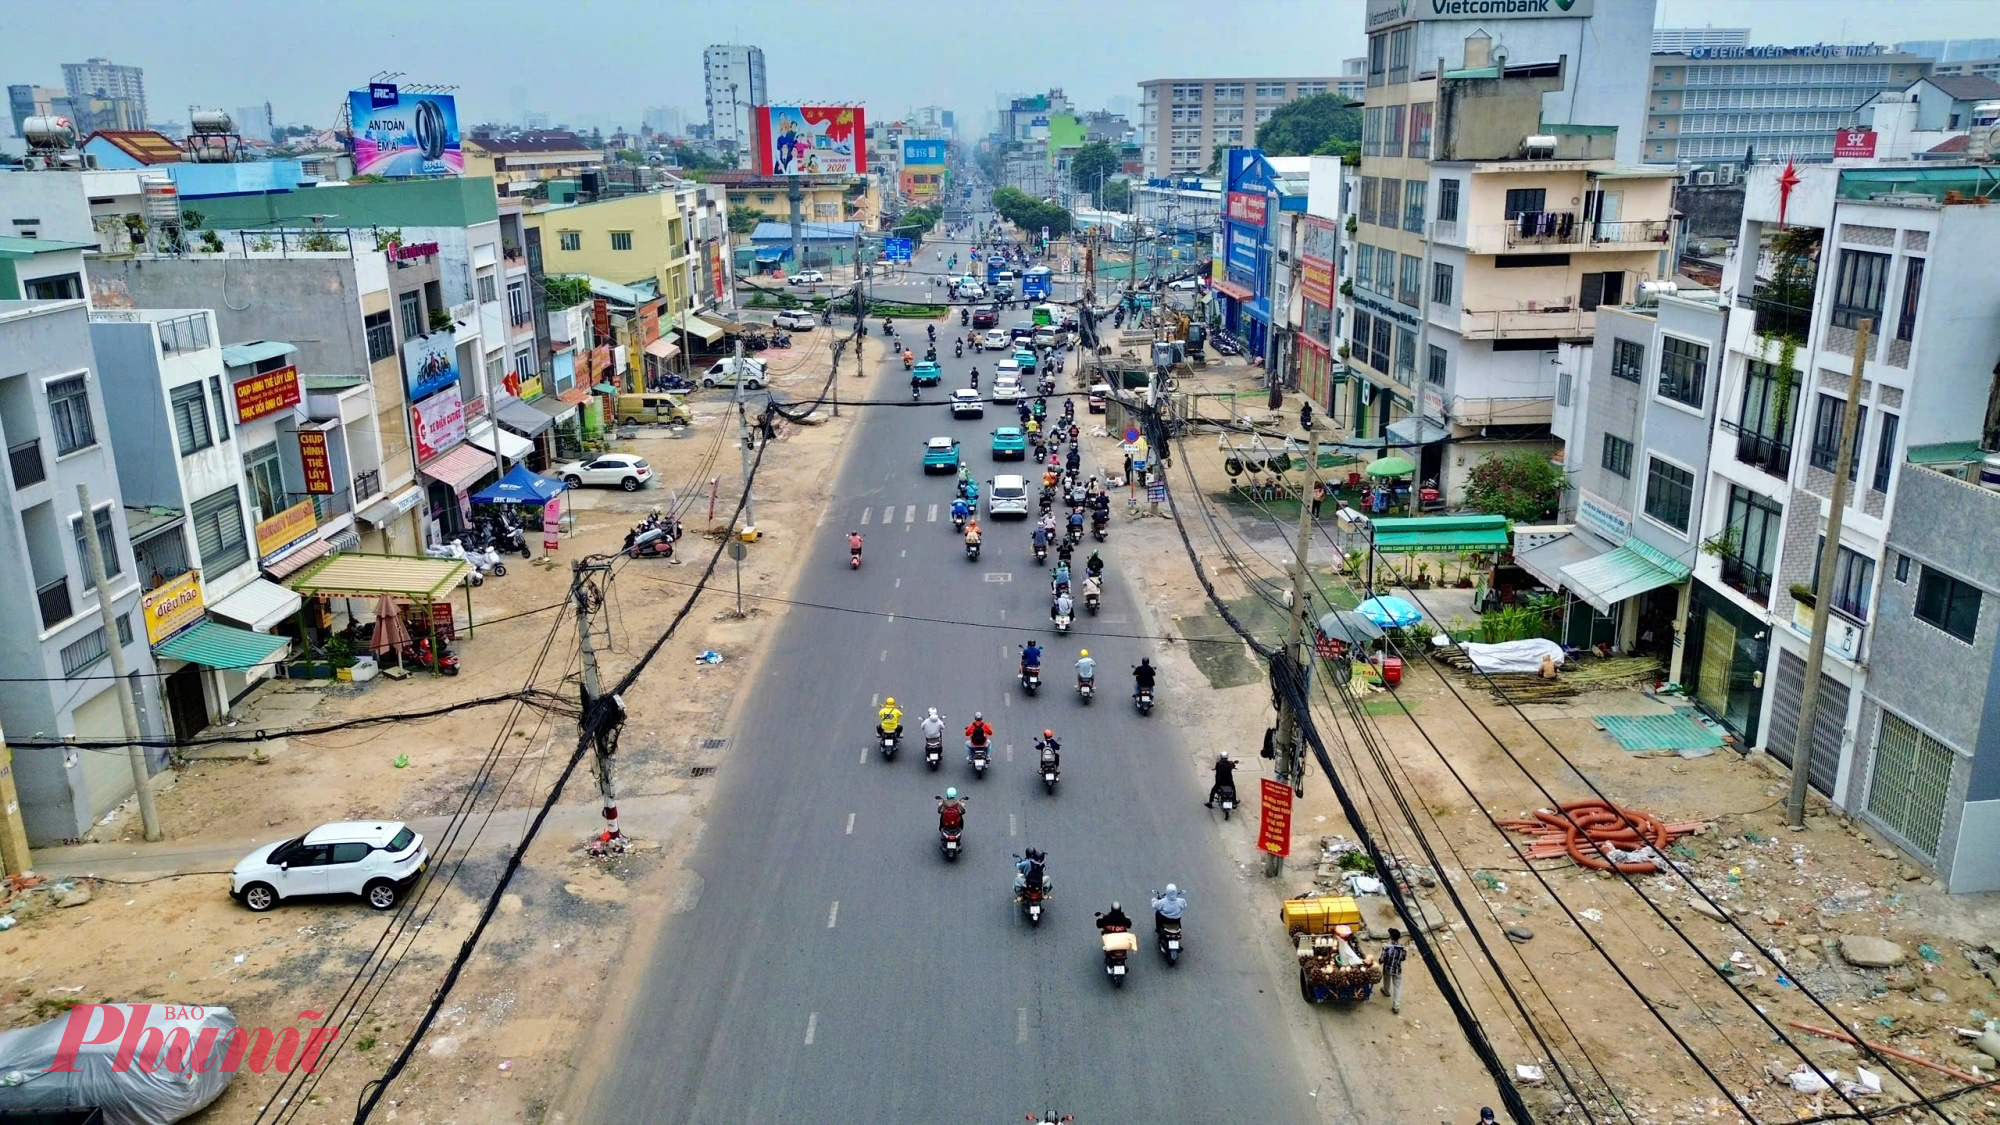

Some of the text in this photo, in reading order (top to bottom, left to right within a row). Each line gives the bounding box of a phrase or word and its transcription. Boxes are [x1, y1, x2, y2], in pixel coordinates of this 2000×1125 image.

[1433, 0, 1548, 14] Vietcombank
[1369, 8, 1400, 26] Vietcombank
[369, 118, 404, 130] AN TOÀN
[1847, 134, 1865, 146] SHZ
[826, 164, 846, 172] 2026
[238, 384, 251, 398] CHỤP
[252, 380, 264, 393] HÌNH
[241, 406, 255, 420] PHỤC
[300, 434, 323, 446] CHỤP
[303, 444, 324, 456] HÌNH
[306, 456, 324, 468] THẺ
[308, 468, 325, 479] LẤY
[157, 599, 178, 618] diệu
